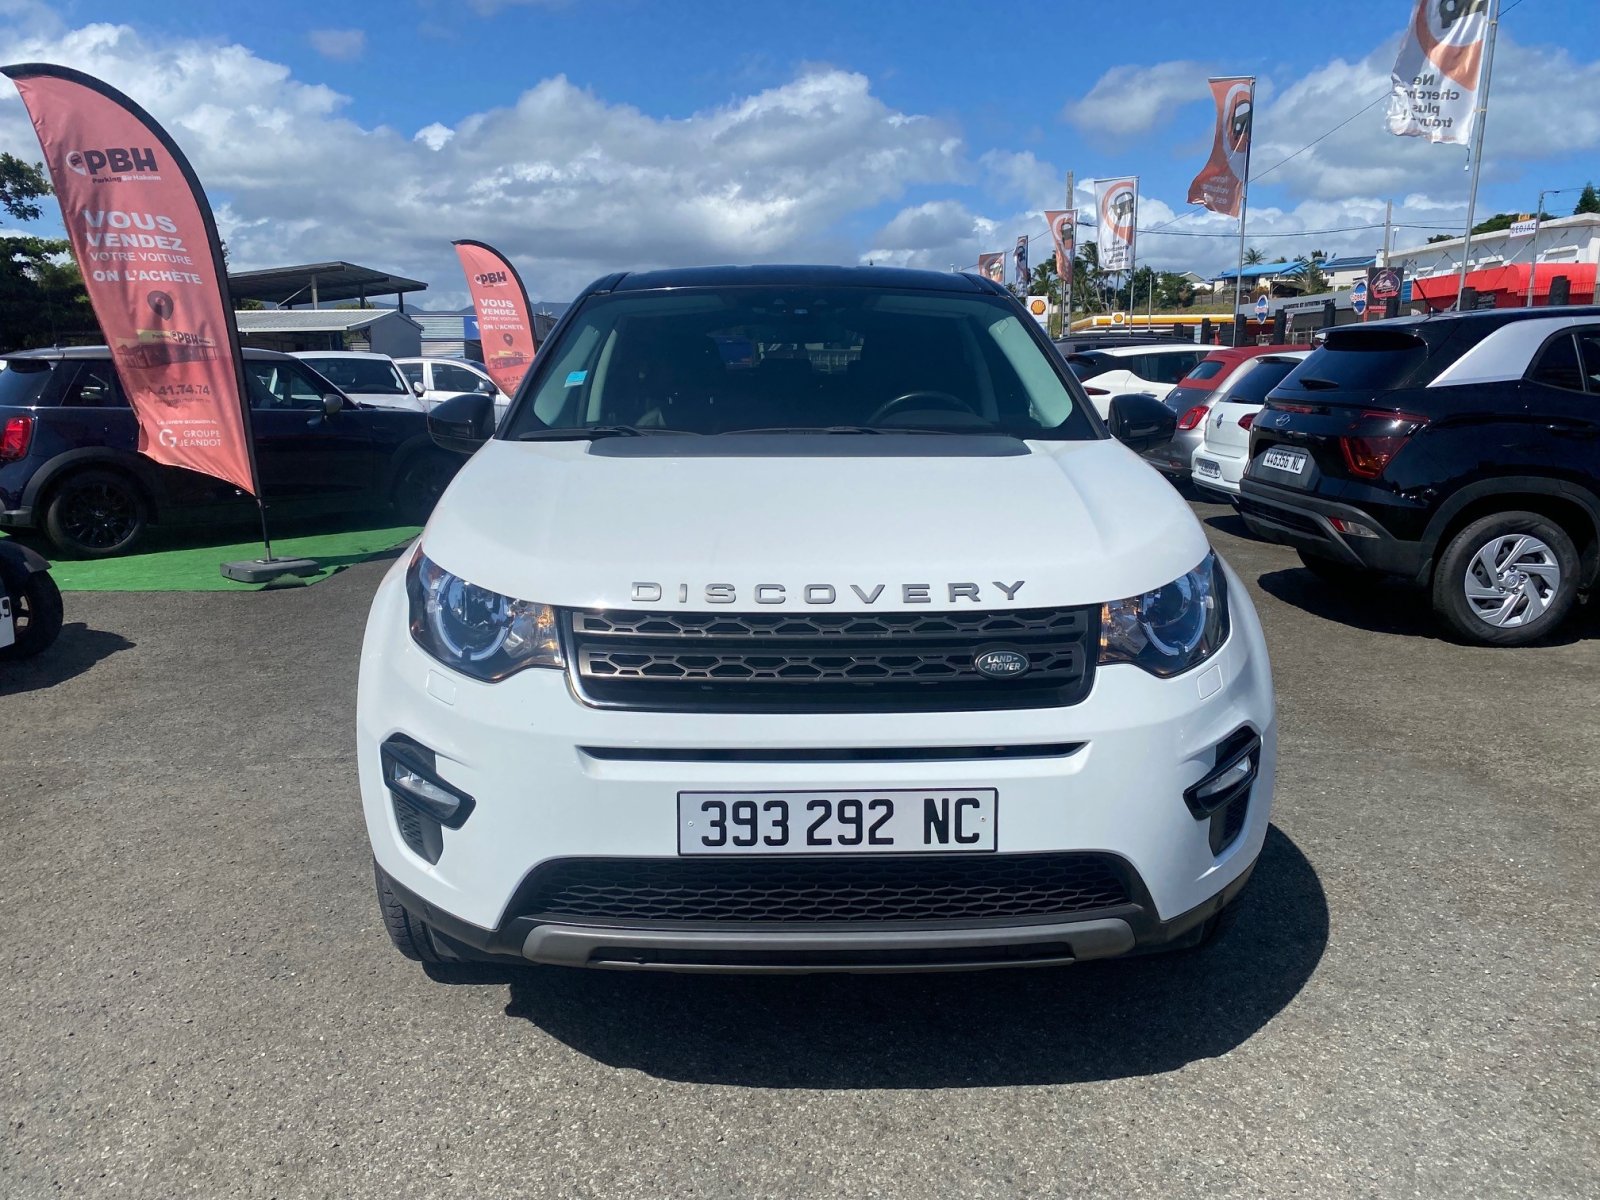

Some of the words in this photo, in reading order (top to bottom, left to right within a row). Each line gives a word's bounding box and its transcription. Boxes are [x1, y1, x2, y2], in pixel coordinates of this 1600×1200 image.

[84, 147, 158, 175] PBH
[82, 209, 177, 233] VOUS
[85, 232, 187, 252] VENDEZ
[90, 251, 136, 262] VOTRE
[139, 252, 193, 265] VOITURE
[93, 270, 119, 282] ON
[480, 271, 507, 284] PBH
[480, 299, 513, 308] VOUS
[481, 308, 518, 316] VENDEZ
[177, 331, 199, 344] PBH
[183, 430, 221, 438] GROUPE
[179, 439, 221, 447] JEANDOT
[631, 580, 1025, 604] DISCOVERY
[987, 655, 1013, 663] LAND
[990, 663, 1021, 671] ROVER
[701, 800, 789, 847] 393
[806, 798, 894, 846] 292
[923, 797, 980, 844] NC
